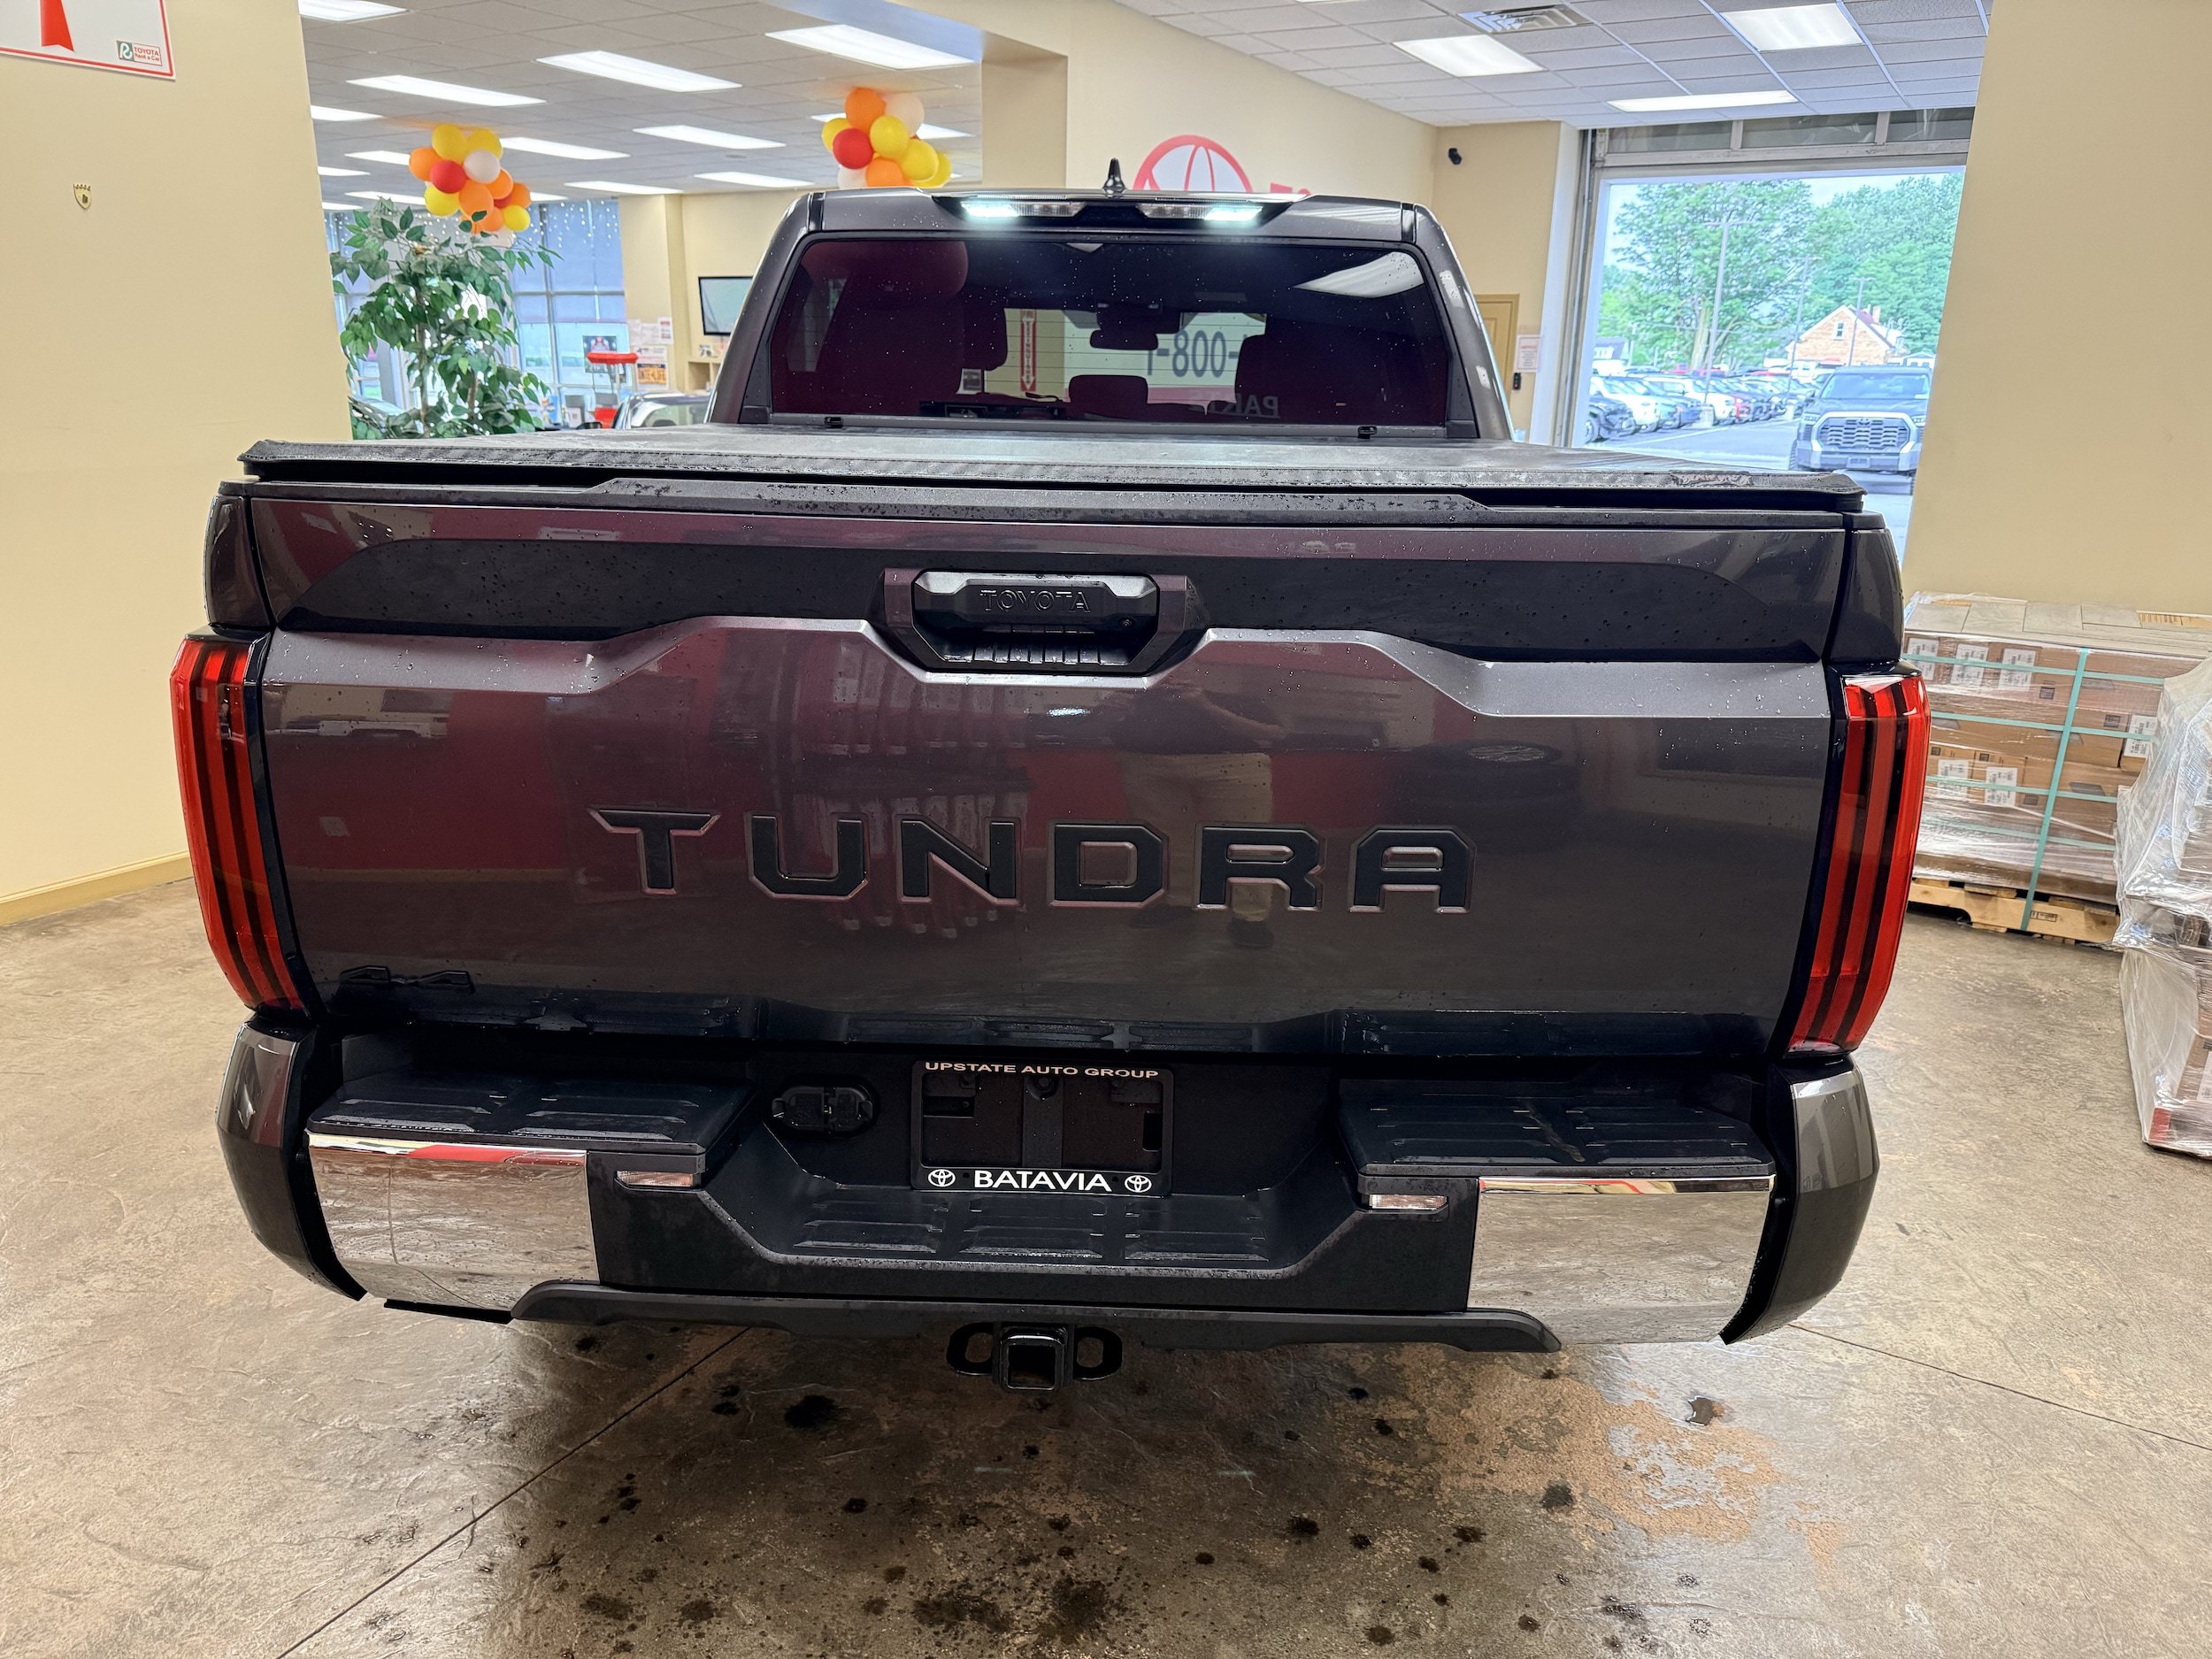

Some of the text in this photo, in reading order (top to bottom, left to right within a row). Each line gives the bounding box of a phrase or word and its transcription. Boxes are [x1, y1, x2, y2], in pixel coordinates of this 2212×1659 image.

[134, 47, 159, 56] TOYOTA
[1147, 330, 1240, 379] 1-800-
[979, 589, 1090, 612] TOYOTA
[588, 806, 1475, 915] TUNDRA
[925, 1061, 1159, 1079] UPSTATE AUTO GROUP
[974, 1170, 1112, 1192] BATAVIA
